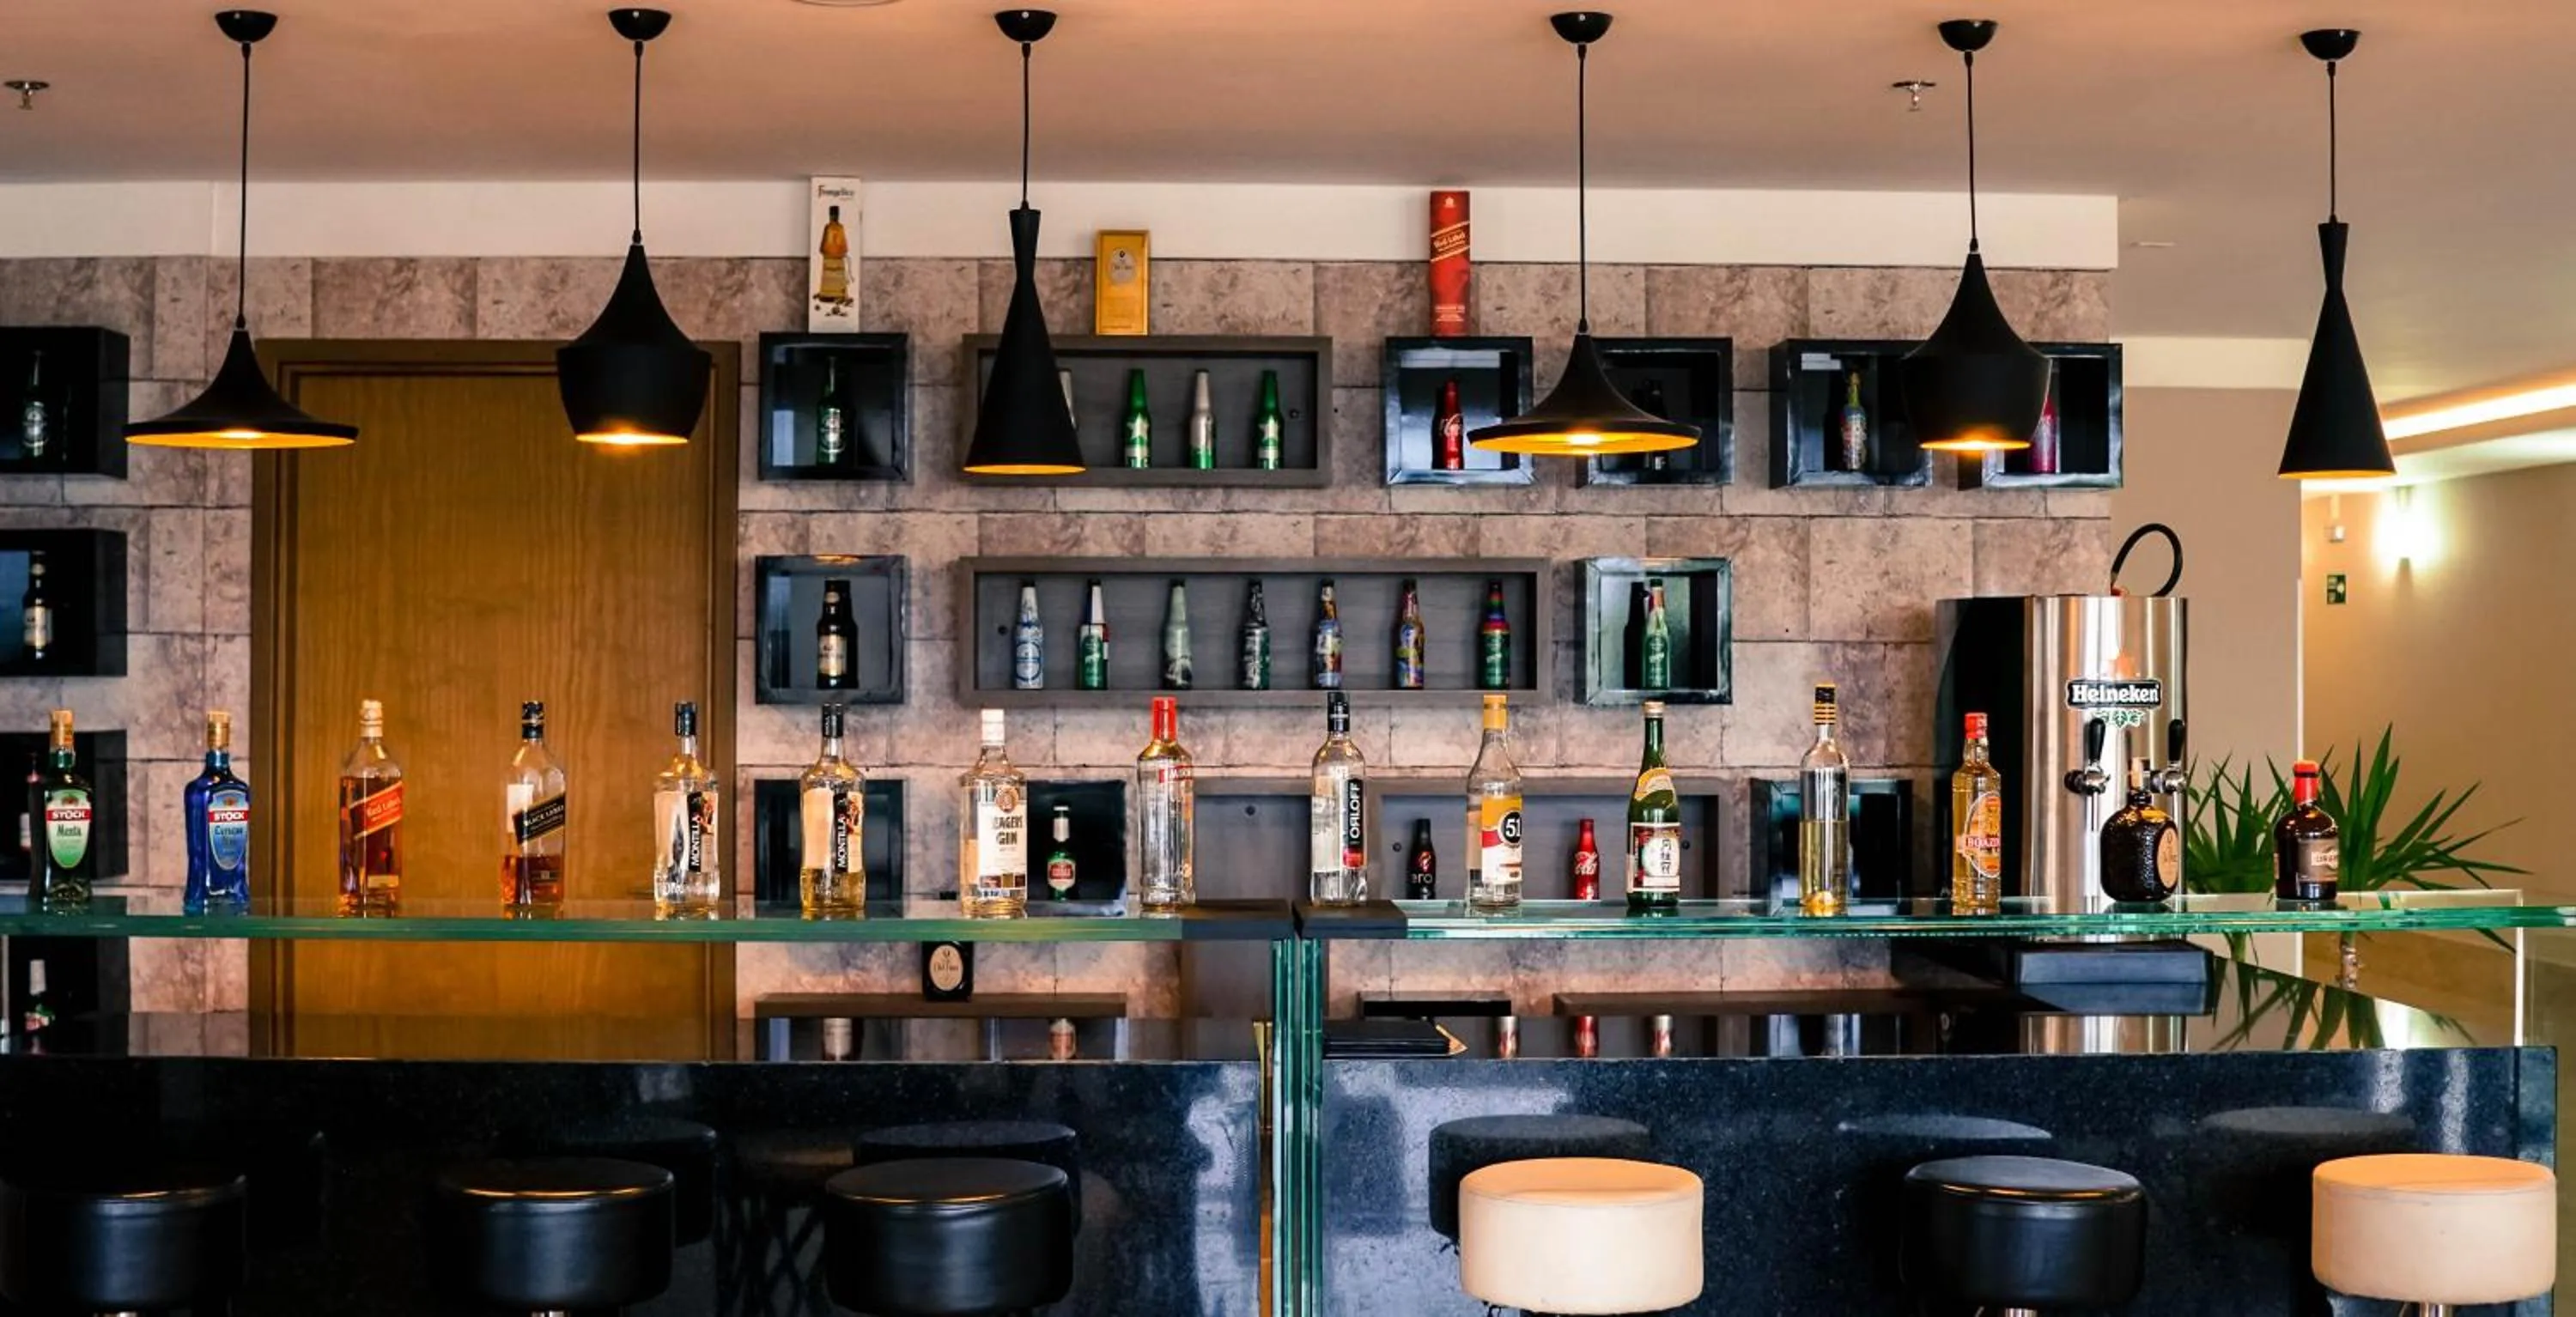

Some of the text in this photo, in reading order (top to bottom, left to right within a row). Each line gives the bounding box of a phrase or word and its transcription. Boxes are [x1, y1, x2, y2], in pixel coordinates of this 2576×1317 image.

[2071, 683, 2160, 702] Heineken
[52, 810, 87, 820] STOCK
[214, 811, 245, 821] STOCK
[1505, 817, 1522, 838] 51
[996, 831, 1018, 845] GIN
